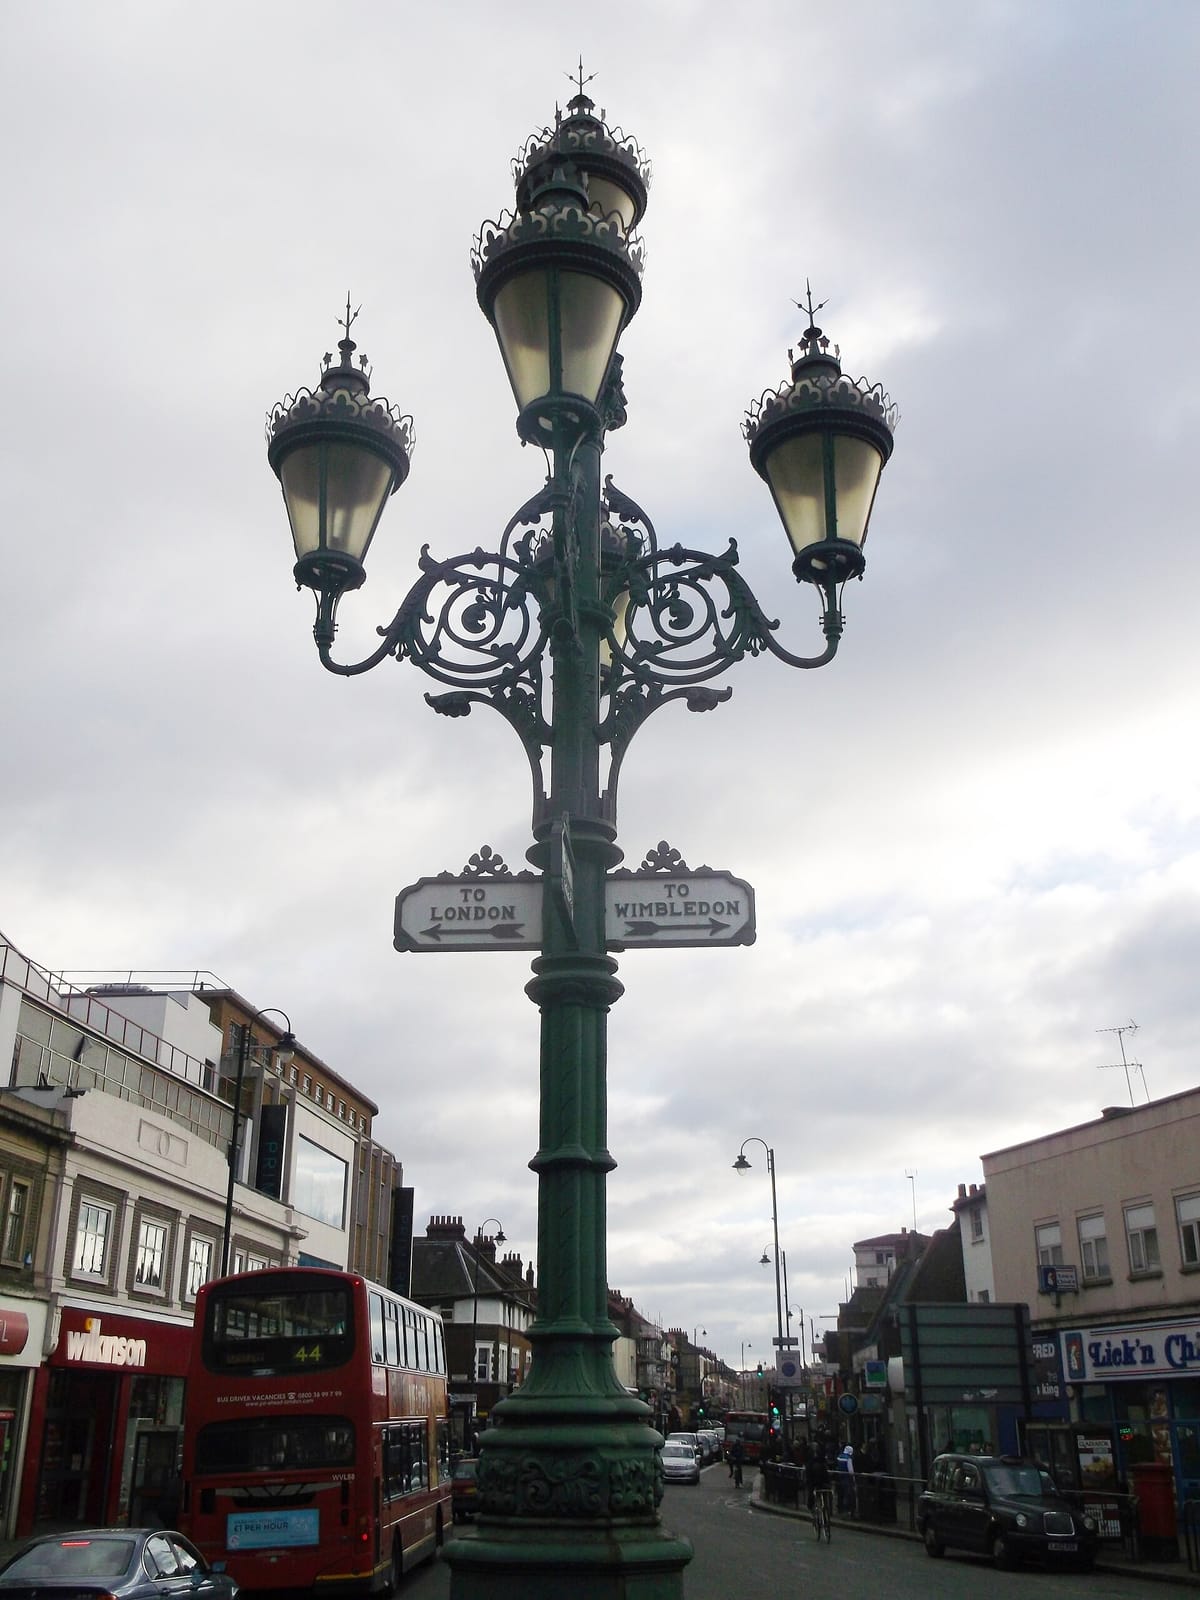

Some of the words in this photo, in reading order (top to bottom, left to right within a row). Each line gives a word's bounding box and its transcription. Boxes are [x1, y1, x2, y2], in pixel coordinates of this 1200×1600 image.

[460, 888, 485, 902] TO
[664, 883, 690, 898] TO
[430, 905, 516, 921] LONDON
[614, 900, 741, 918] WIMBLEDON
[67, 1317, 147, 1366] wilkinson
[295, 1345, 321, 1362] 44
[1089, 1338, 1155, 1367] Lick'n
[252, 1393, 286, 1401] VACANCIES
[245, 1523, 261, 1532] PER
[264, 1521, 289, 1530] HOUR
